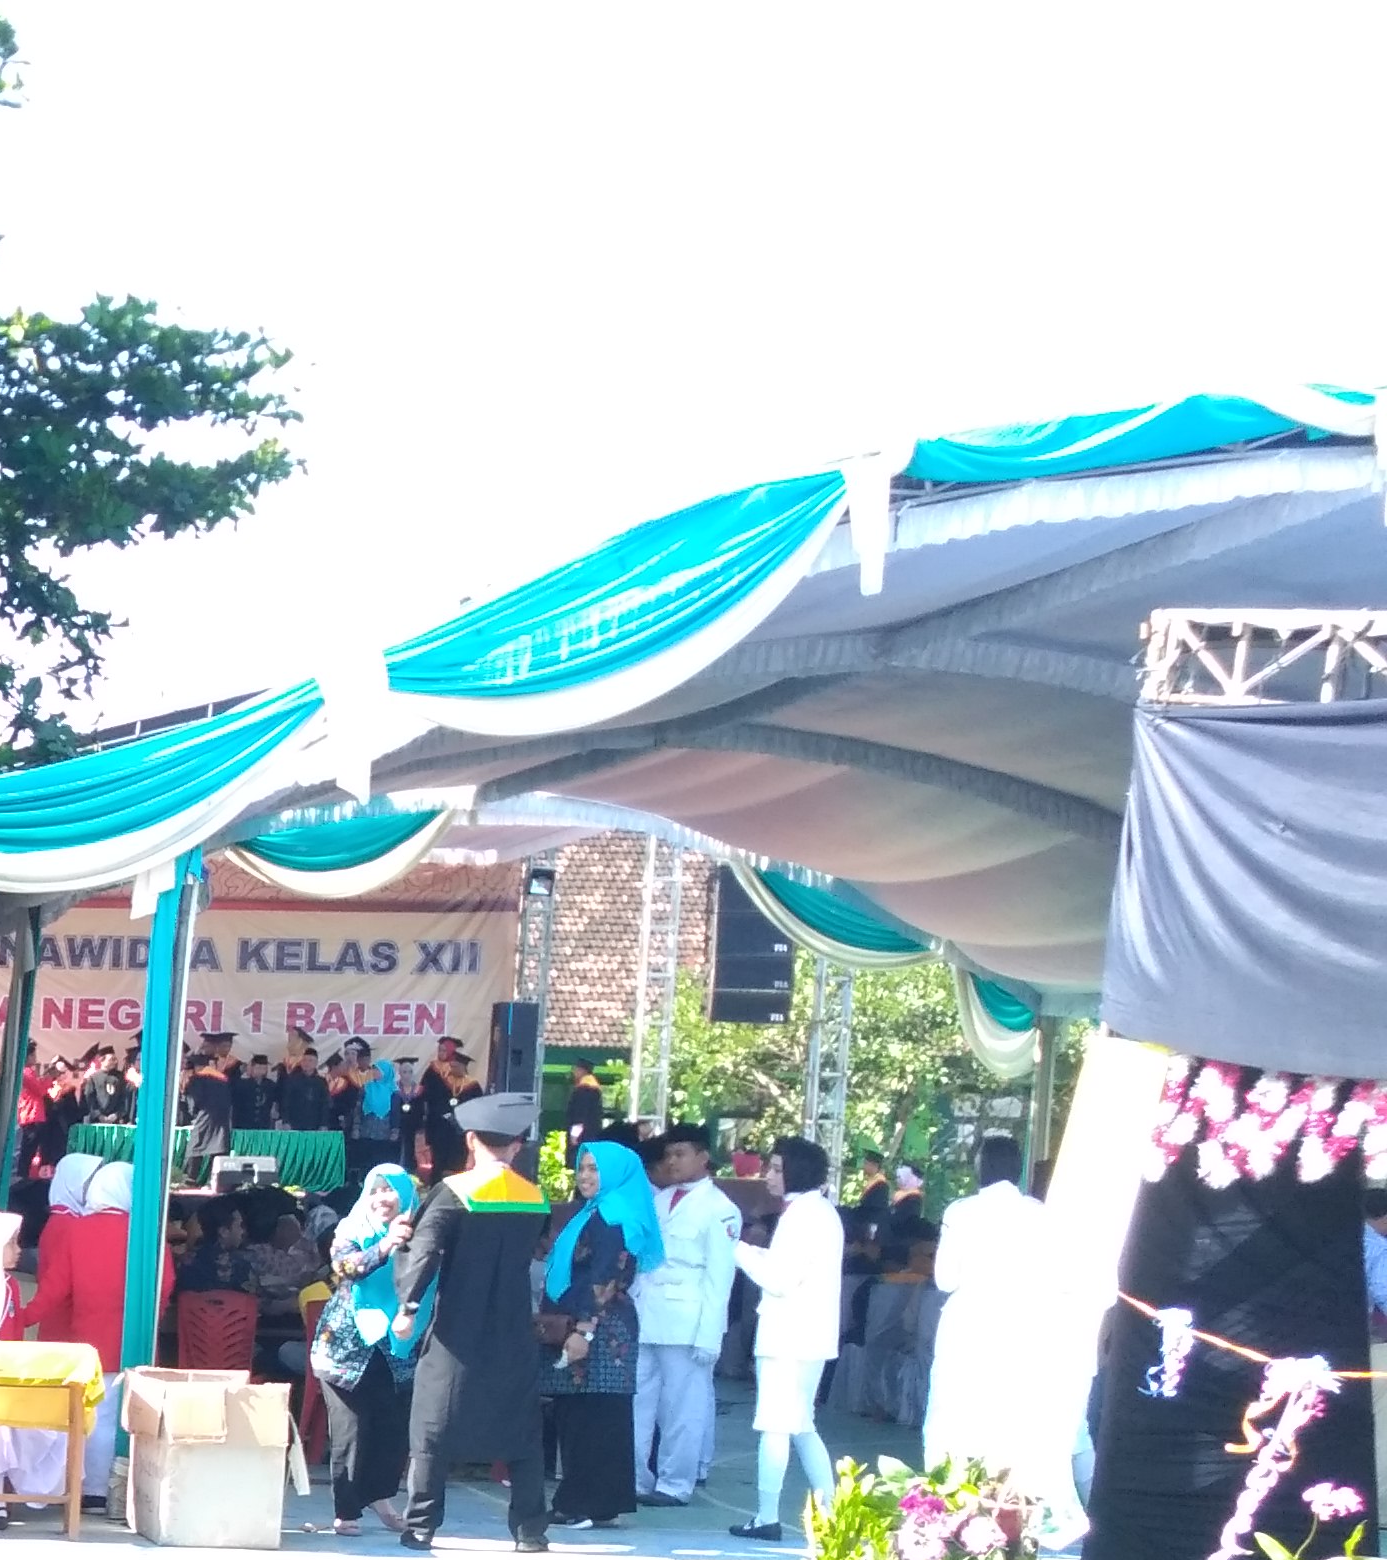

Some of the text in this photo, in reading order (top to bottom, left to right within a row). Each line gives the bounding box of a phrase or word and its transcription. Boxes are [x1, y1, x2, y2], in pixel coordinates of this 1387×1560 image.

[236, 937, 400, 976] KELAS
[410, 939, 483, 976] XII
[41, 996, 224, 1032] NEGRI
[241, 1000, 264, 1034] 1
[284, 1000, 448, 1036] BALEN
